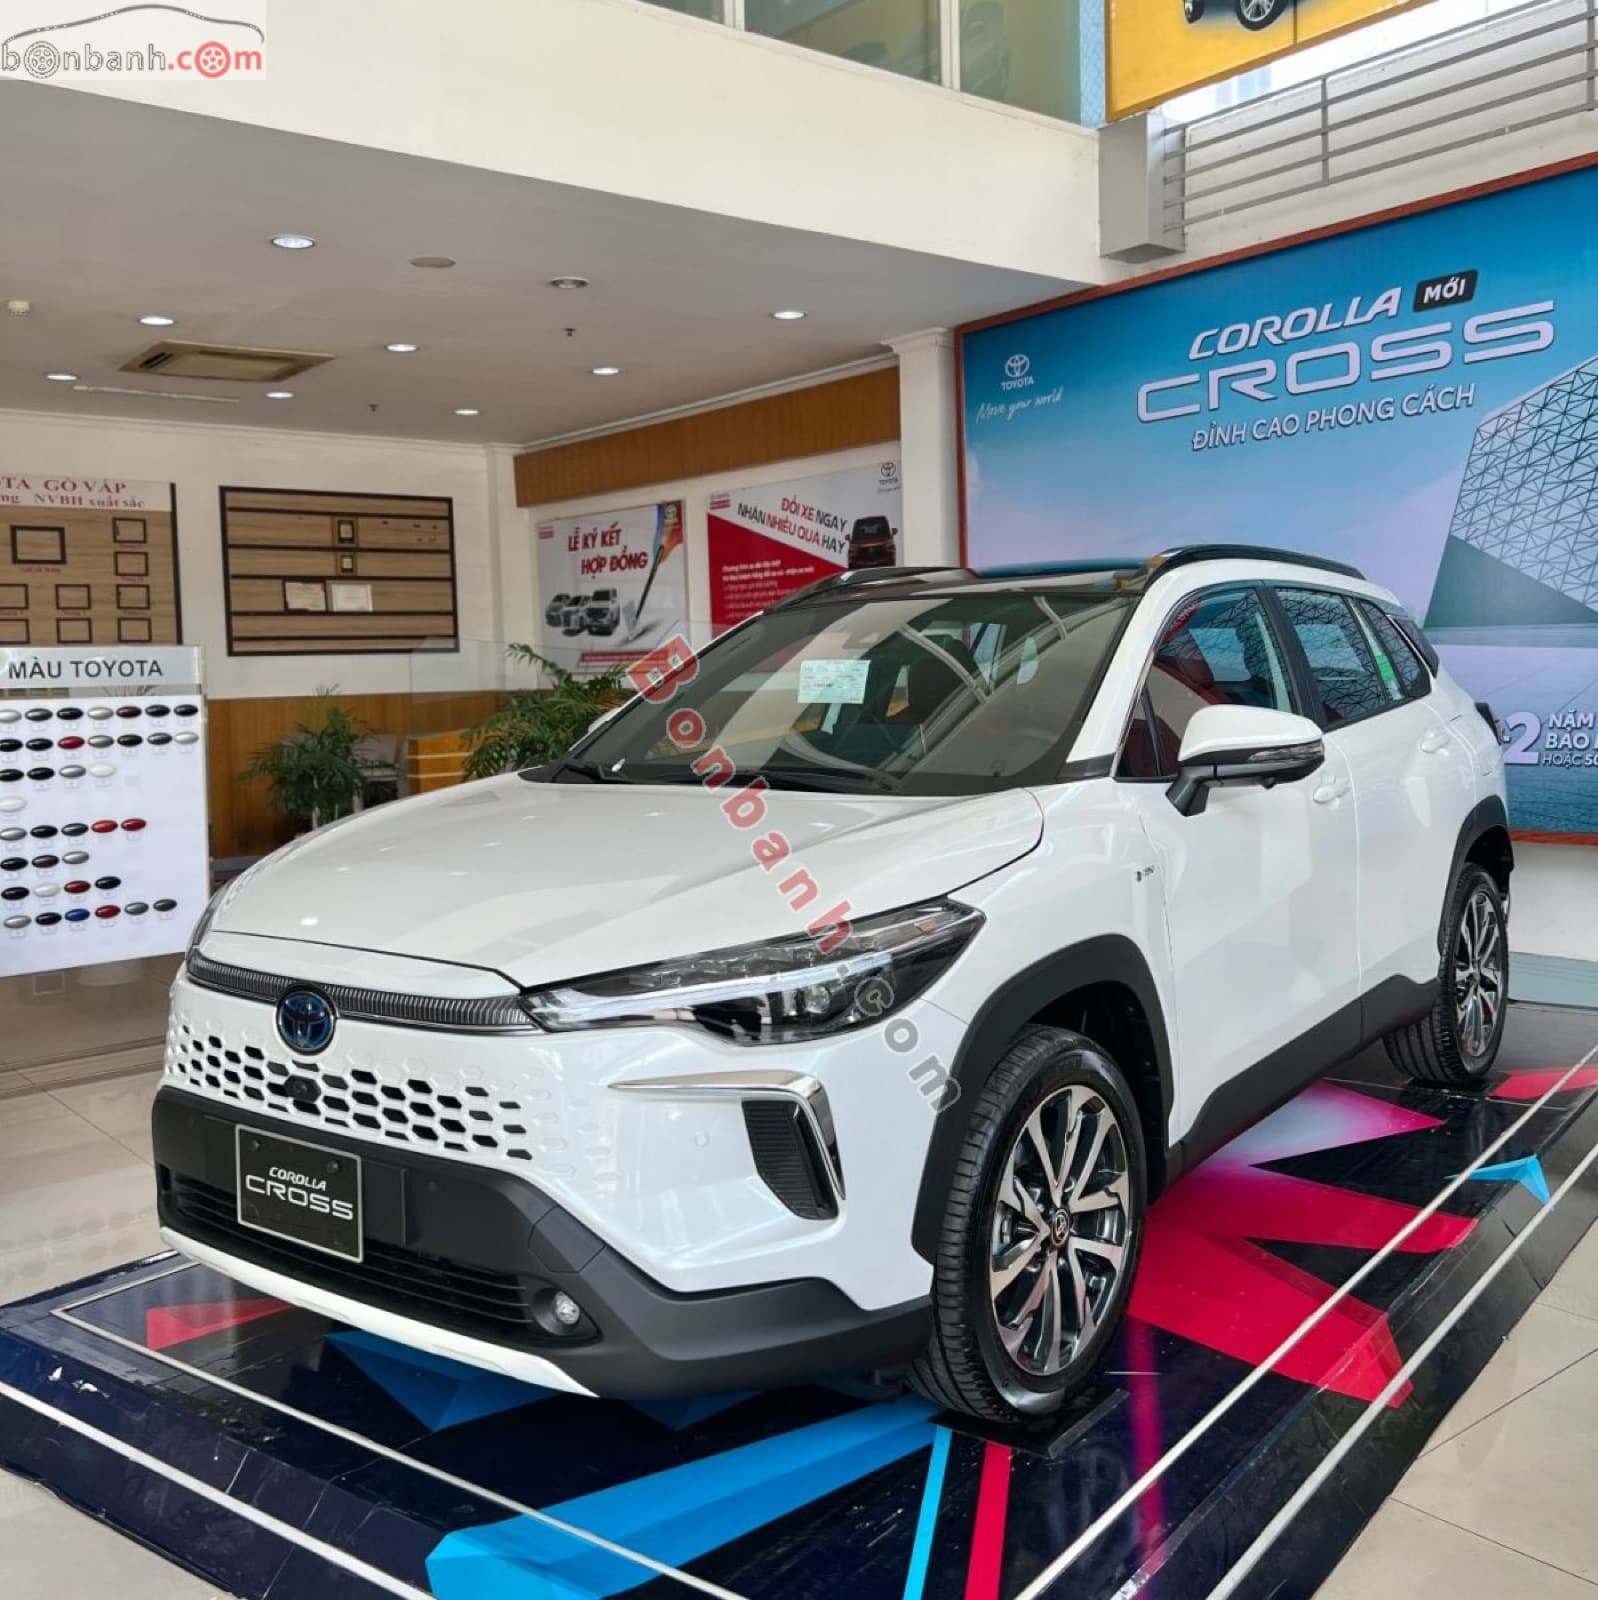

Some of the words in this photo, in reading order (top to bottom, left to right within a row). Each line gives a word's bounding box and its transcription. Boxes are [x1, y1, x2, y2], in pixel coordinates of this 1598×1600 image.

[1188, 287, 1402, 360] COROLLA
[1423, 276, 1467, 304] MỚI
[1137, 300, 1555, 423] CROSS
[1001, 376, 1034, 391] TOYOTA
[1034, 384, 1064, 407] world
[1192, 421, 1246, 450] ĐỈNH
[1252, 414, 1301, 440] CAO
[1305, 397, 1396, 432] PHONG
[1401, 383, 1476, 417] CÁCH
[0, 476, 31, 490] TA
[801, 505, 815, 521] XE
[815, 510, 848, 532] NGAY
[821, 532, 846, 554] HAY
[8, 656, 62, 679] MÀU
[70, 659, 163, 679] TOYOTA
[1548, 709, 1595, 729] NĂM
[1545, 726, 1591, 750] BẢO
[1542, 752, 1582, 769] HOẶC
[269, 1167, 327, 1191] COROLLA
[246, 1174, 354, 1221] CROSS
